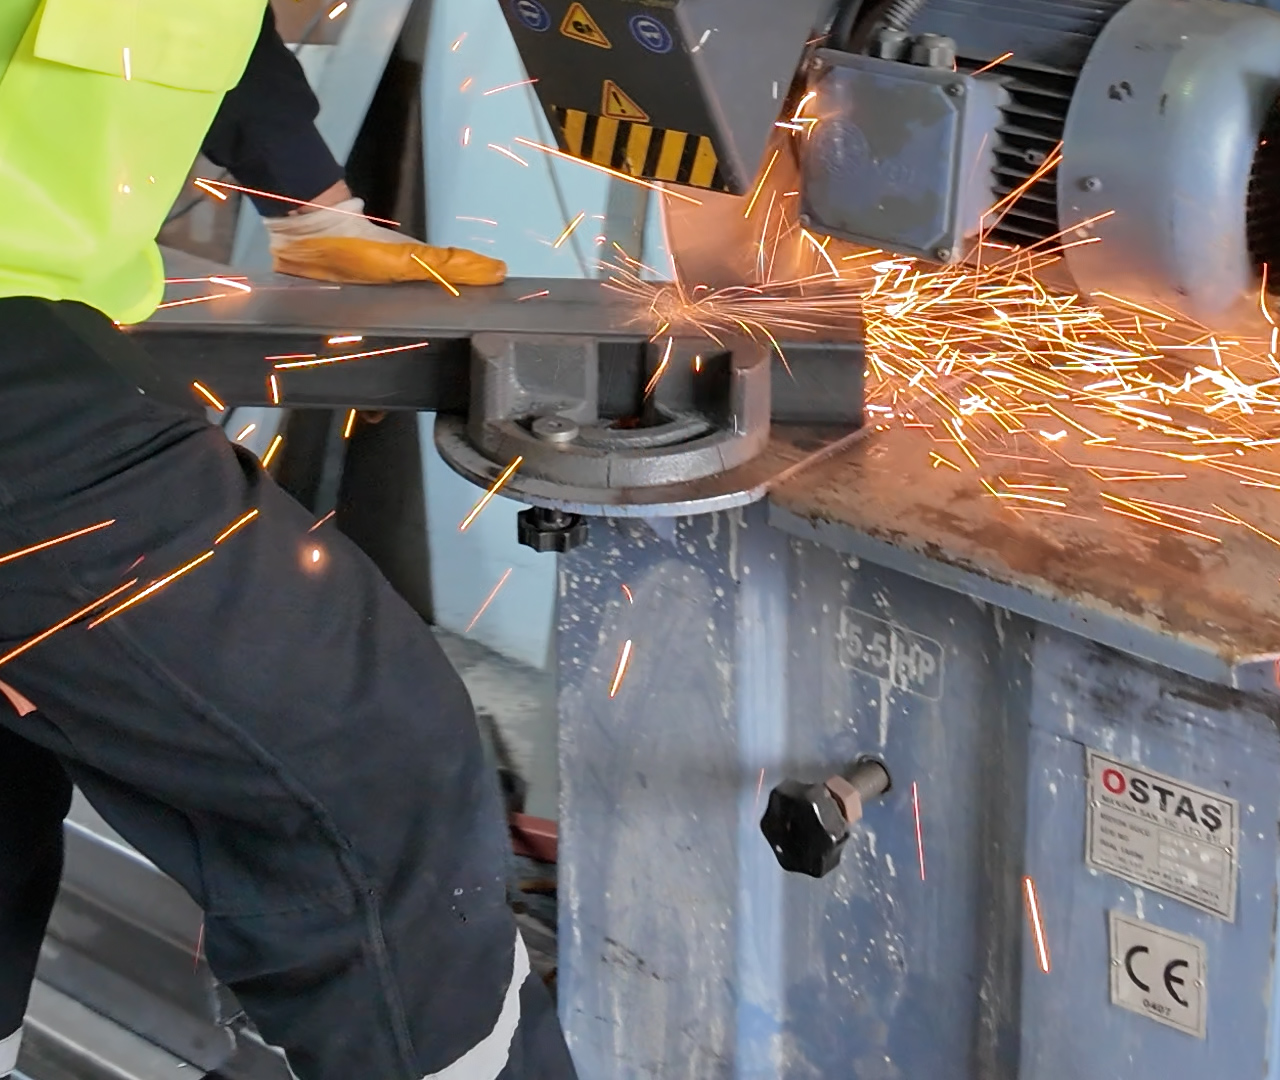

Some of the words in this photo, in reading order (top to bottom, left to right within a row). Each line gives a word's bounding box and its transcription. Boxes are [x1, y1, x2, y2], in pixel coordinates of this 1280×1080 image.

[845, 624, 888, 668] 5.5
[1101, 768, 1223, 832] OSTAŞ
[1124, 945, 1189, 1009] CE
